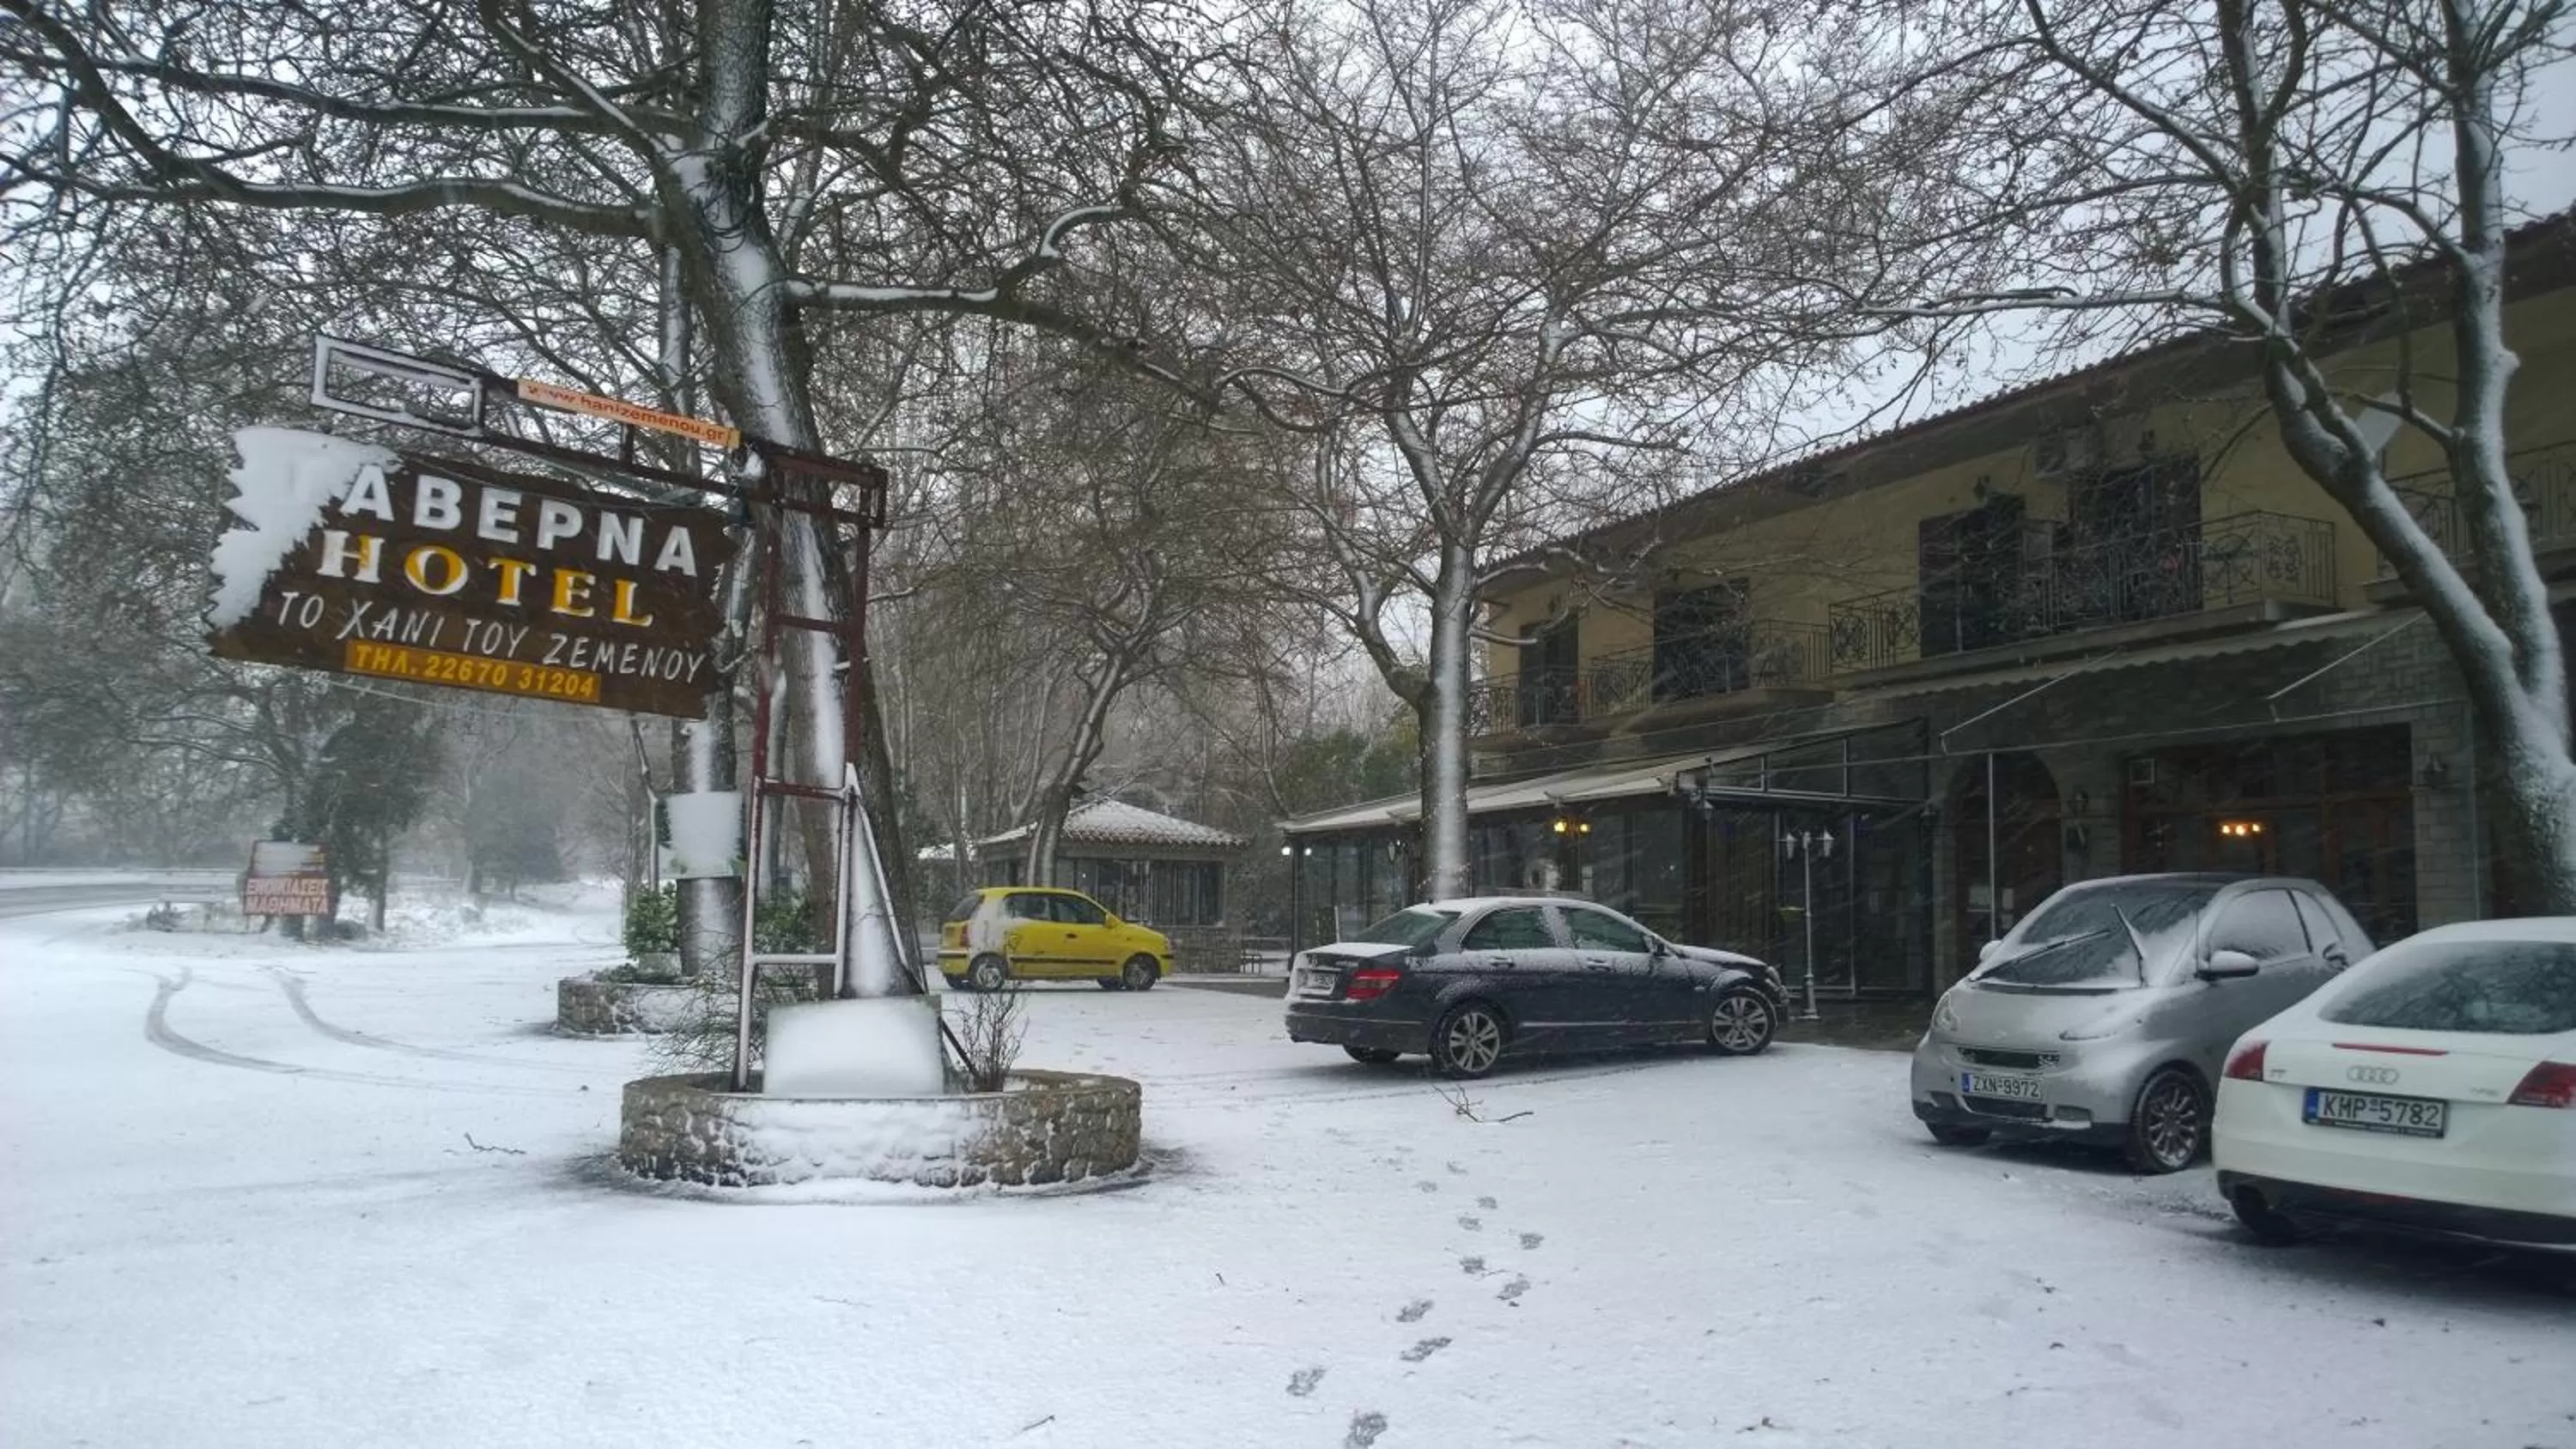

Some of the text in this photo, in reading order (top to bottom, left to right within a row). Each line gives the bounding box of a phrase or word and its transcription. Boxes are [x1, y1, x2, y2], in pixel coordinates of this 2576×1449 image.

[340, 462, 698, 578] ΑΒΕΡΝΑ
[316, 529, 655, 627] HOTEL
[278, 591, 707, 684] ΤΟ ΧΑΝΙ ΤΟΥ ΖΕΜΕΝΟΥ
[422, 654, 507, 687] 22670
[518, 667, 594, 697] 31204
